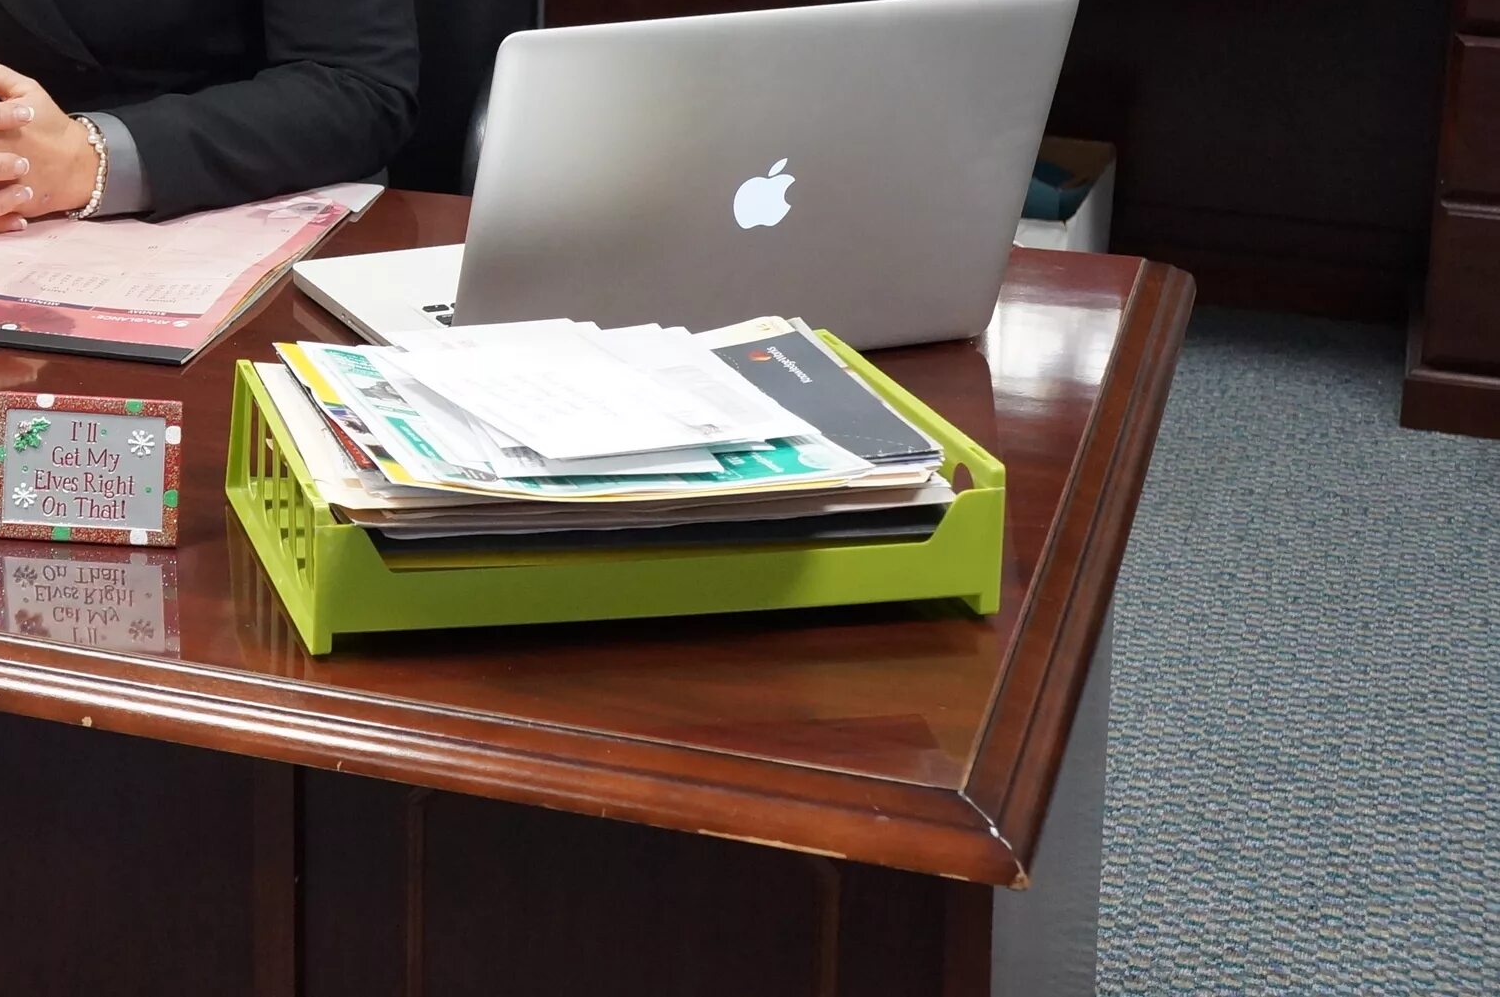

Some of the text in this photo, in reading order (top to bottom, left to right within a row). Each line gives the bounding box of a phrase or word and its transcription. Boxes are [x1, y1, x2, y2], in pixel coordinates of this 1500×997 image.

[19, 297, 61, 307] MONDAY
[127, 308, 167, 316] SUNDAY
[71, 421, 98, 444] I'll
[52, 446, 120, 473] Get My
[34, 469, 136, 499] Elves Right
[42, 496, 127, 520] On That!
